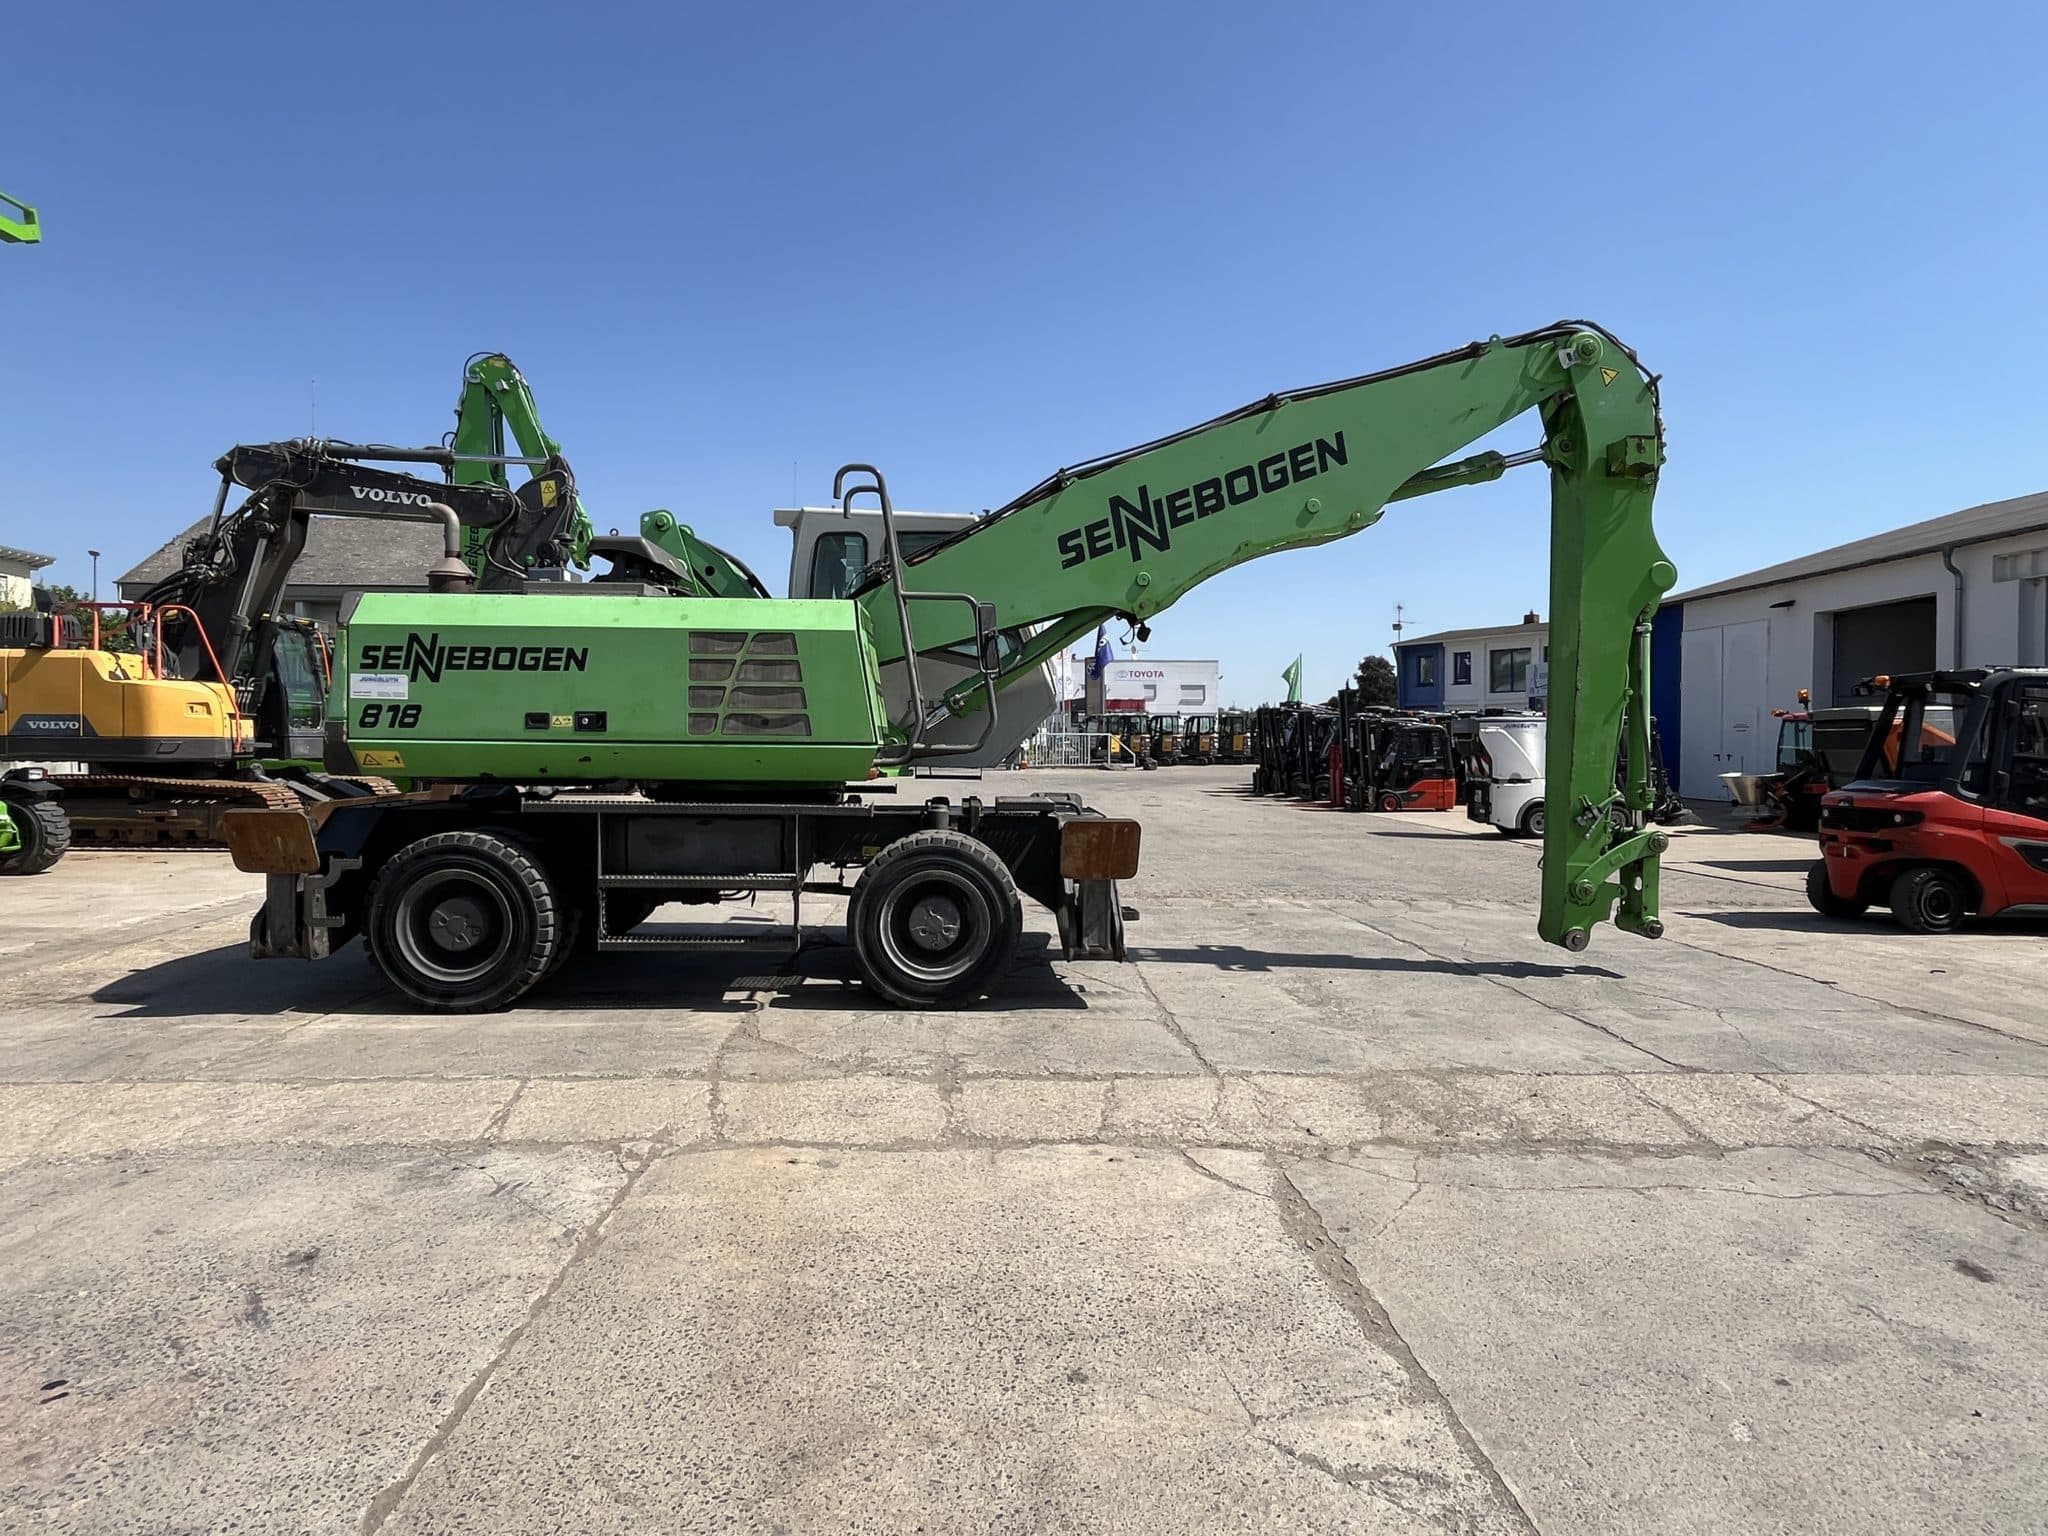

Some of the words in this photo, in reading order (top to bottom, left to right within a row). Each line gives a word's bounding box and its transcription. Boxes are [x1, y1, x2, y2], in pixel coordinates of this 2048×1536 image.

[350, 485, 432, 508] VOLVO
[1057, 431, 1348, 569] SENNEBOGEN
[360, 633, 588, 682] SENNEBOGEN
[1129, 670, 1164, 678] TOYOTA
[26, 720, 79, 729] VOLVO
[359, 703, 422, 728] 818
